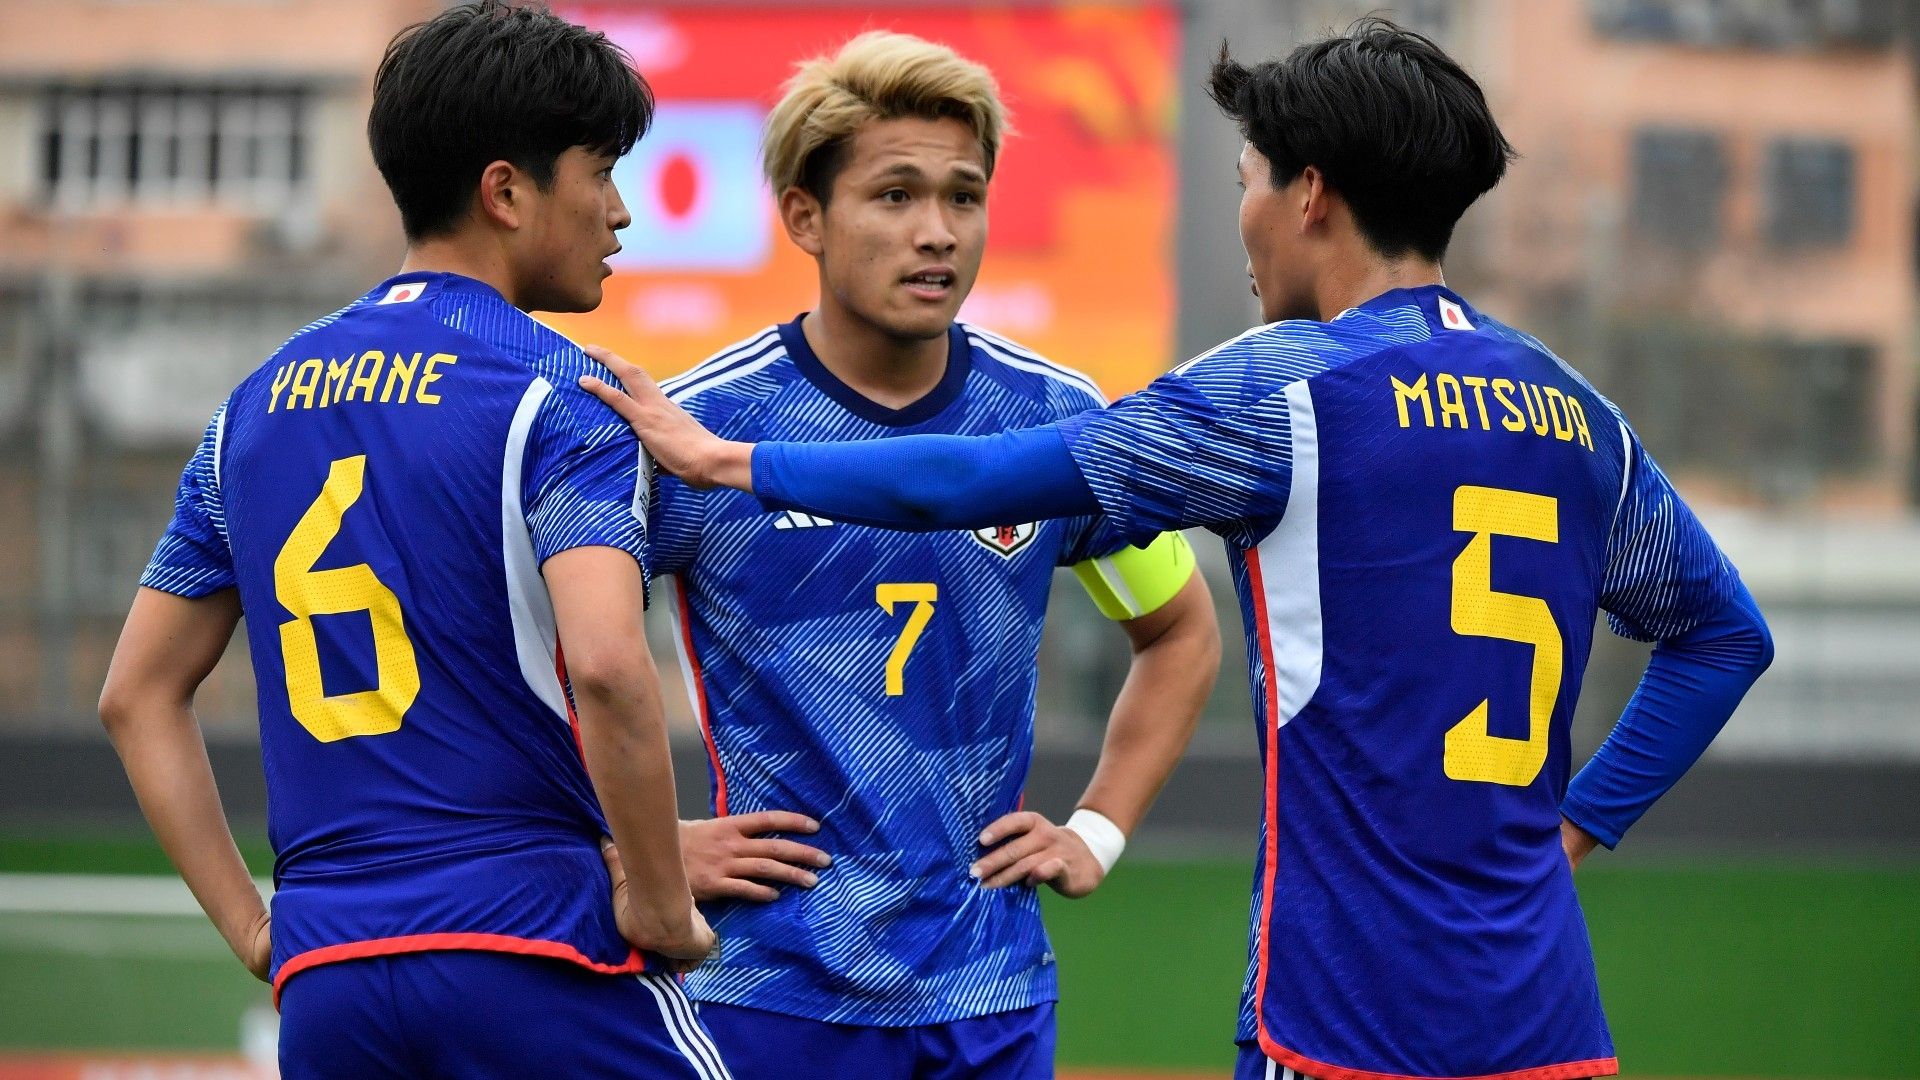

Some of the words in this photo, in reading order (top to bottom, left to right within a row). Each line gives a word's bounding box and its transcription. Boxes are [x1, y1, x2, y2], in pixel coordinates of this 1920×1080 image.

[268, 350, 459, 413] YAMANE
[1393, 375, 1594, 453] MATSUDA
[274, 456, 420, 742] 6
[875, 583, 938, 696] 7
[1444, 486, 1564, 785] 5
